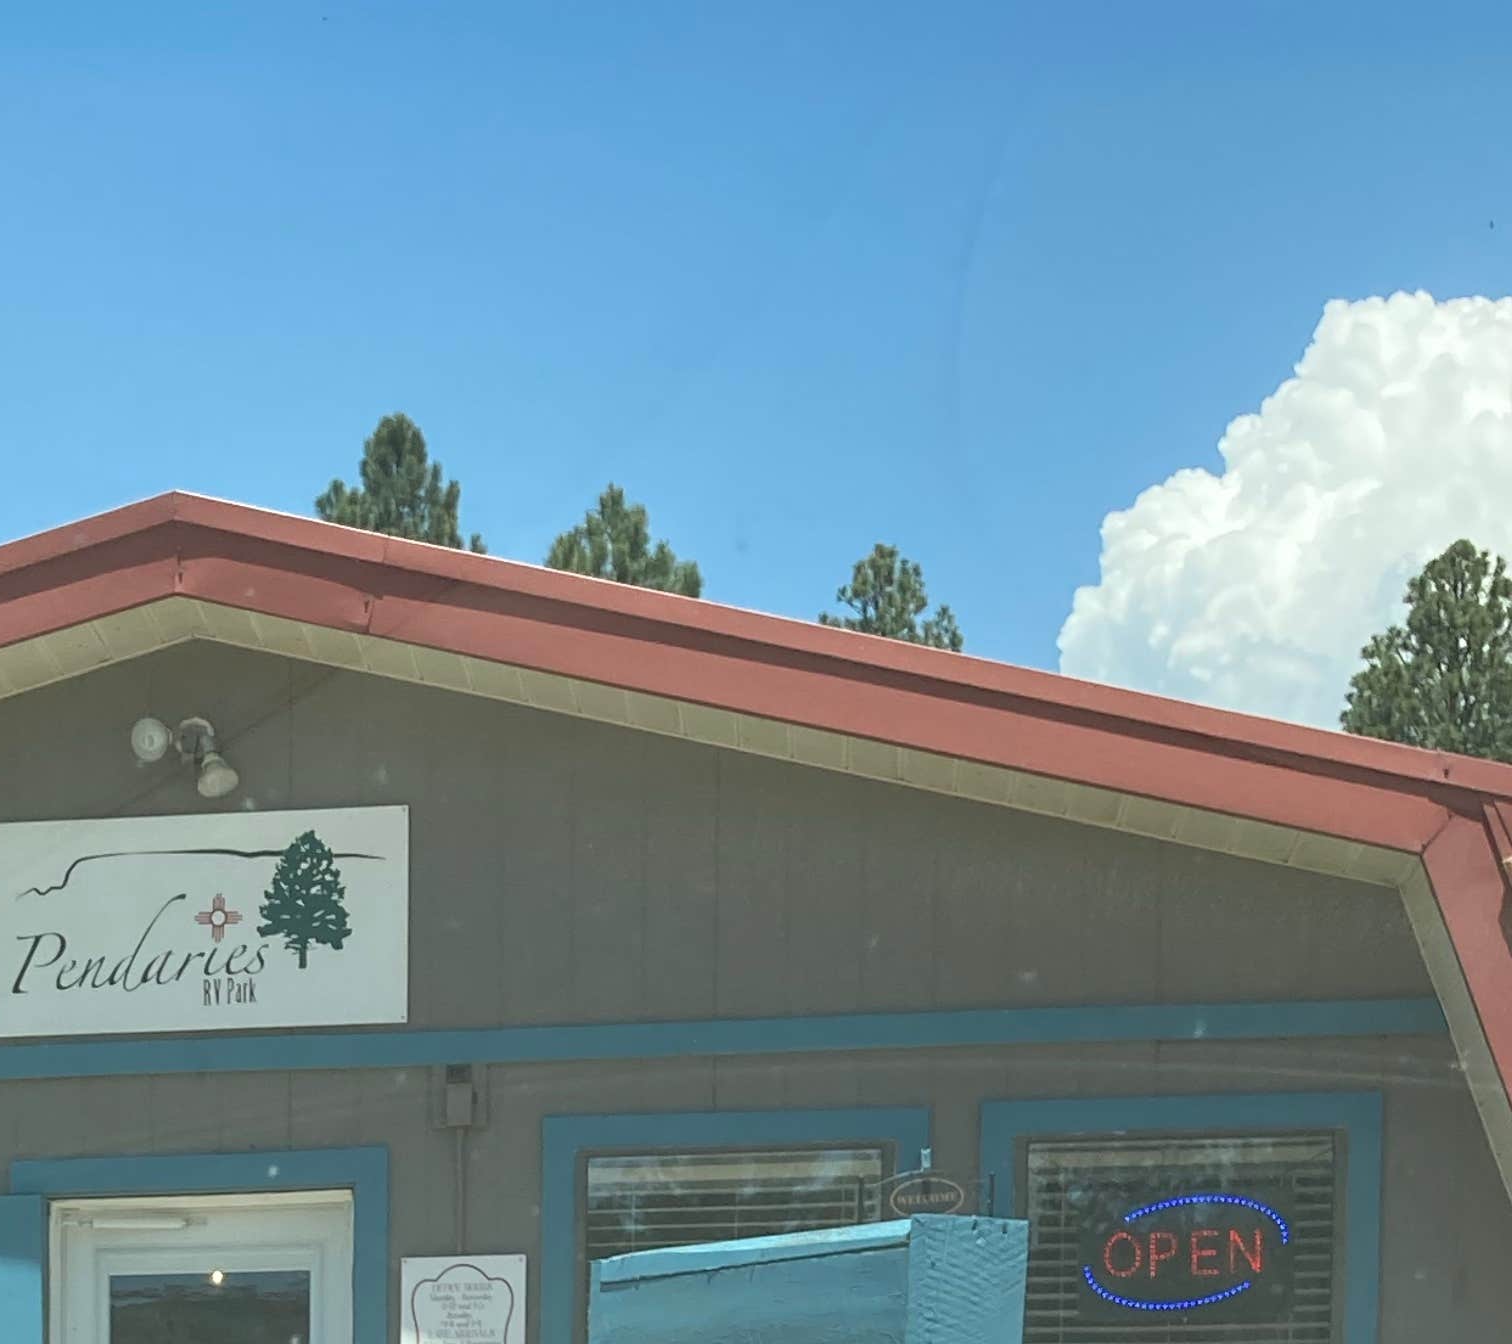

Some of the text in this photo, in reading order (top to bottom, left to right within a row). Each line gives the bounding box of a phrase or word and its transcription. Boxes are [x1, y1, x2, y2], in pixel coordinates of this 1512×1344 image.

[11, 893, 269, 995] Pendaries
[203, 977, 257, 1006] RV Park
[1103, 1228, 1264, 1279] OPEN
